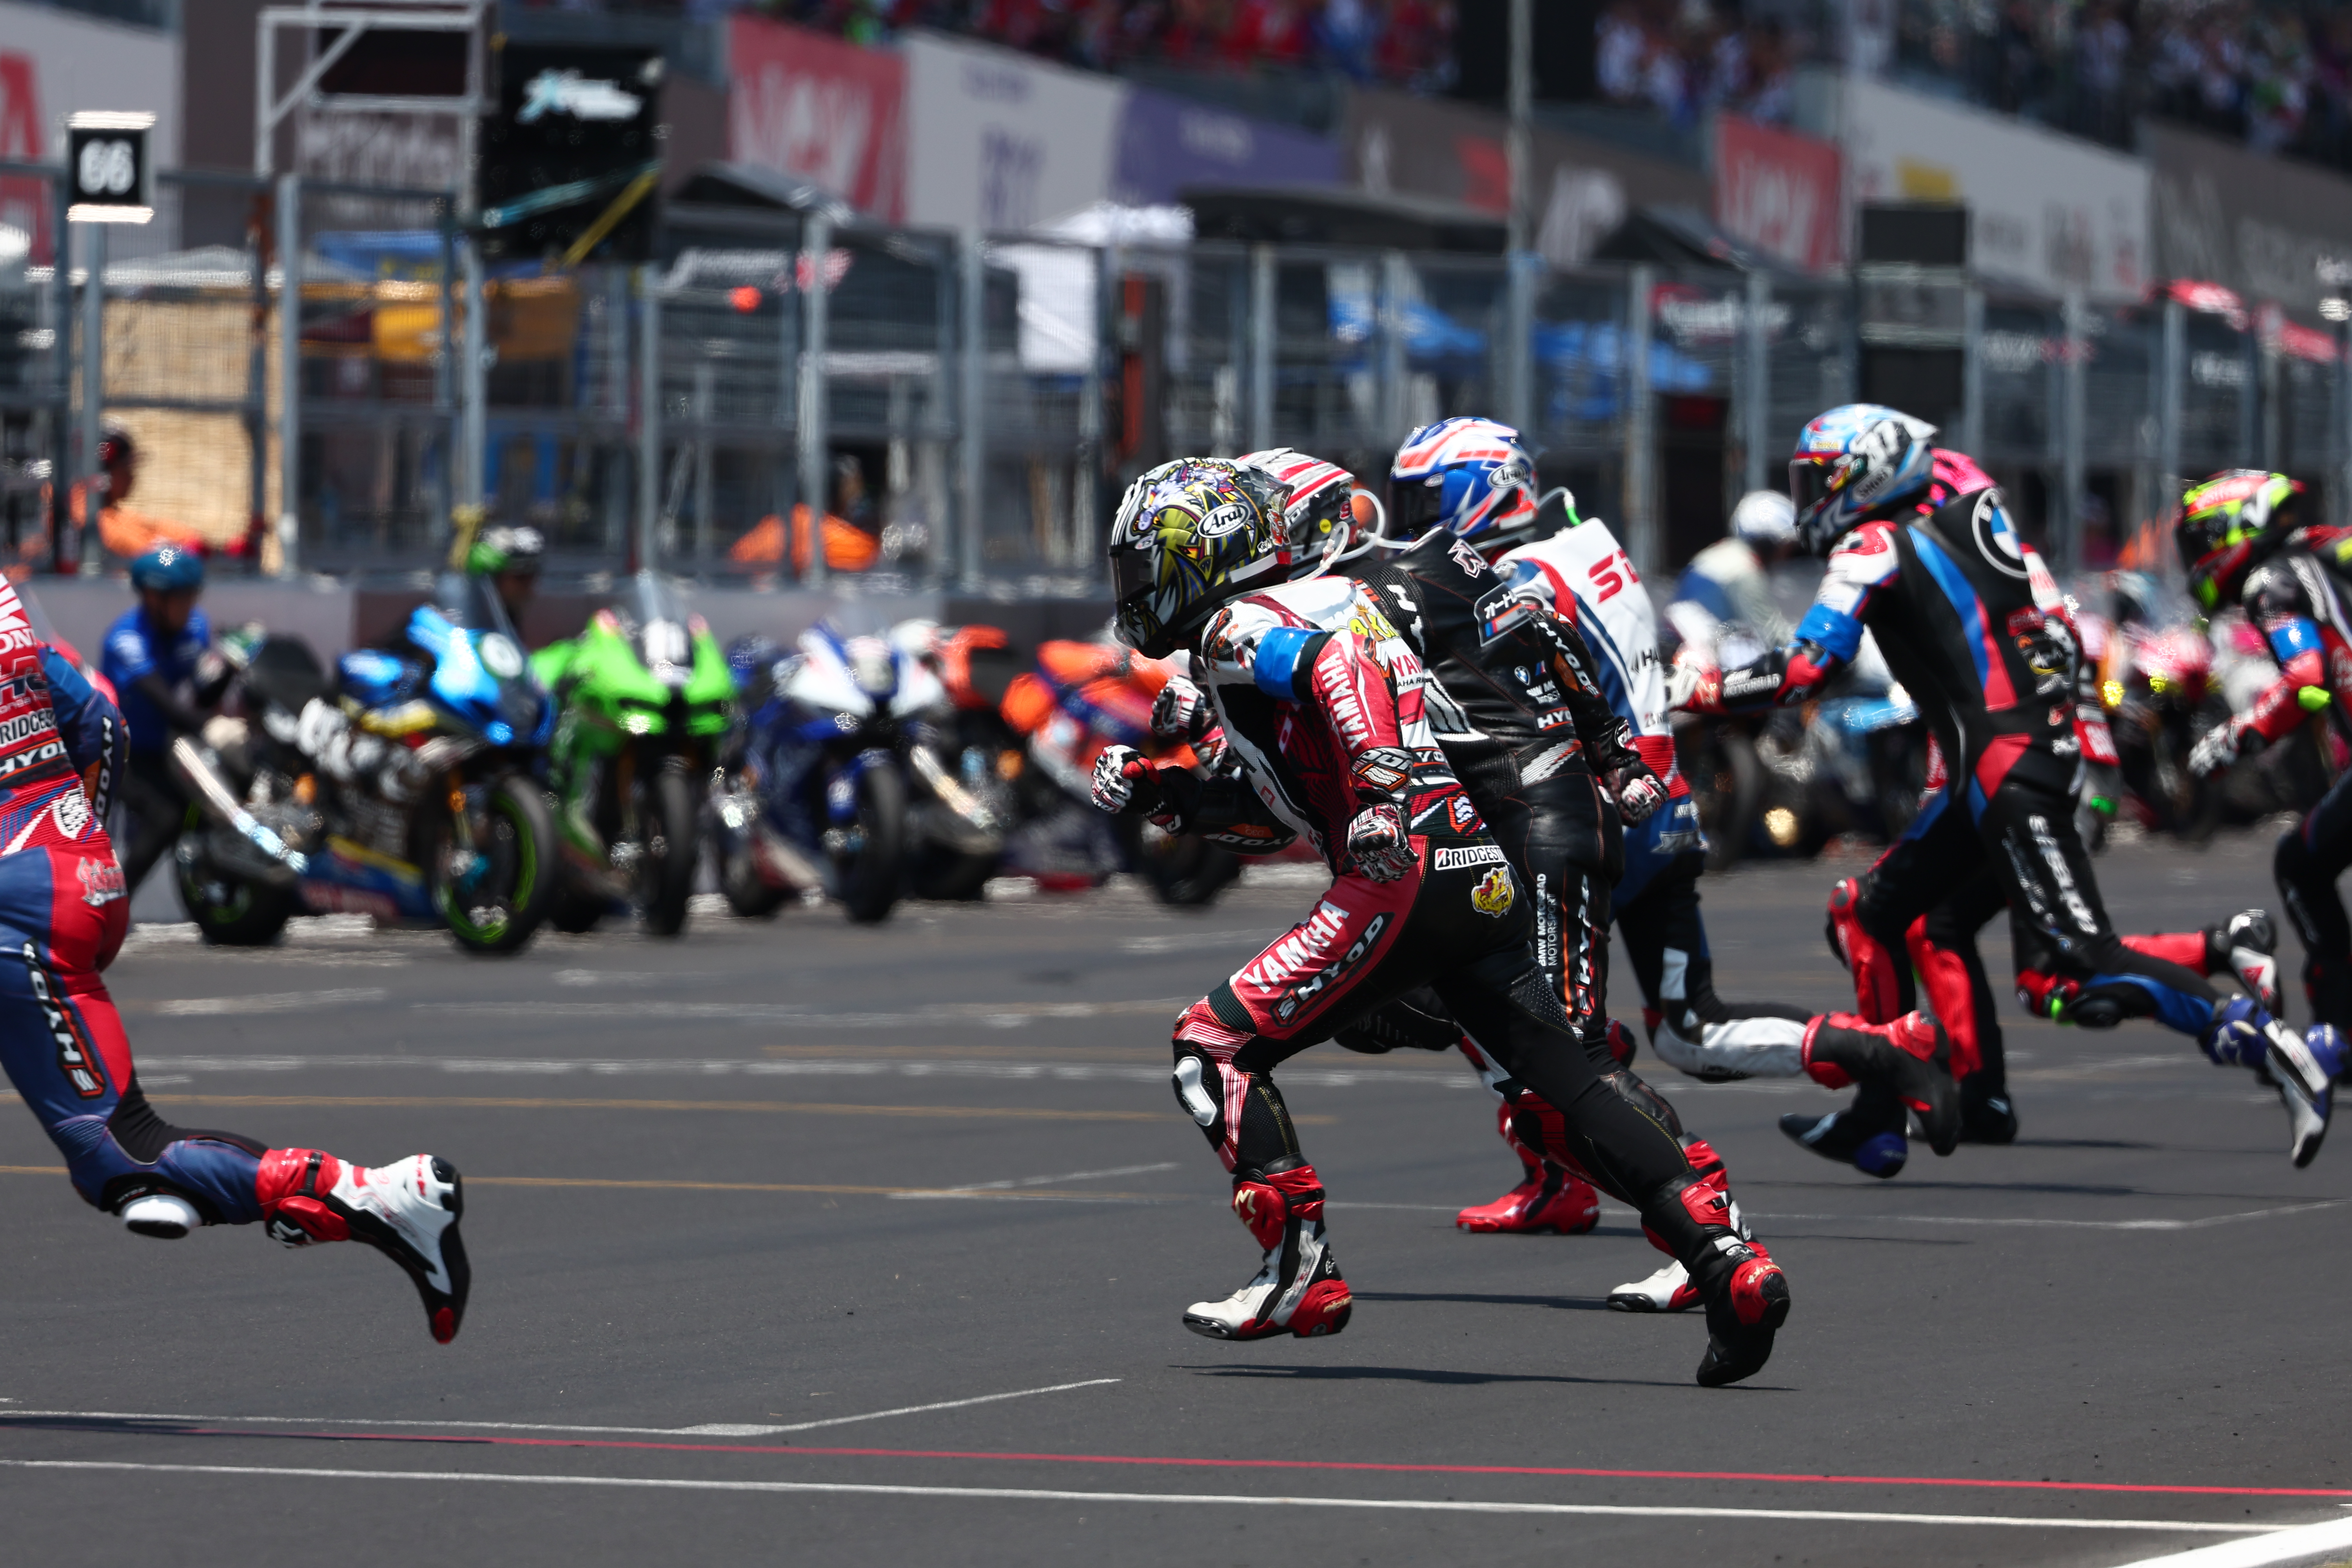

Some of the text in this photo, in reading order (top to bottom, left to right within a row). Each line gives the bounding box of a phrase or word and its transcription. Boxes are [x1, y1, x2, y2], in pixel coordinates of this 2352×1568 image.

[1205, 505, 1243, 534] Arai
[1318, 651, 1369, 750] YAMAHA
[1437, 847, 1506, 868] BRIDGESTO
[1242, 900, 1350, 994] YAMAHA
[1298, 915, 1383, 1001] HYOD
[1537, 873, 1547, 966] BMW MOTORRAD
[1547, 894, 1559, 966] MOTORSPORT
